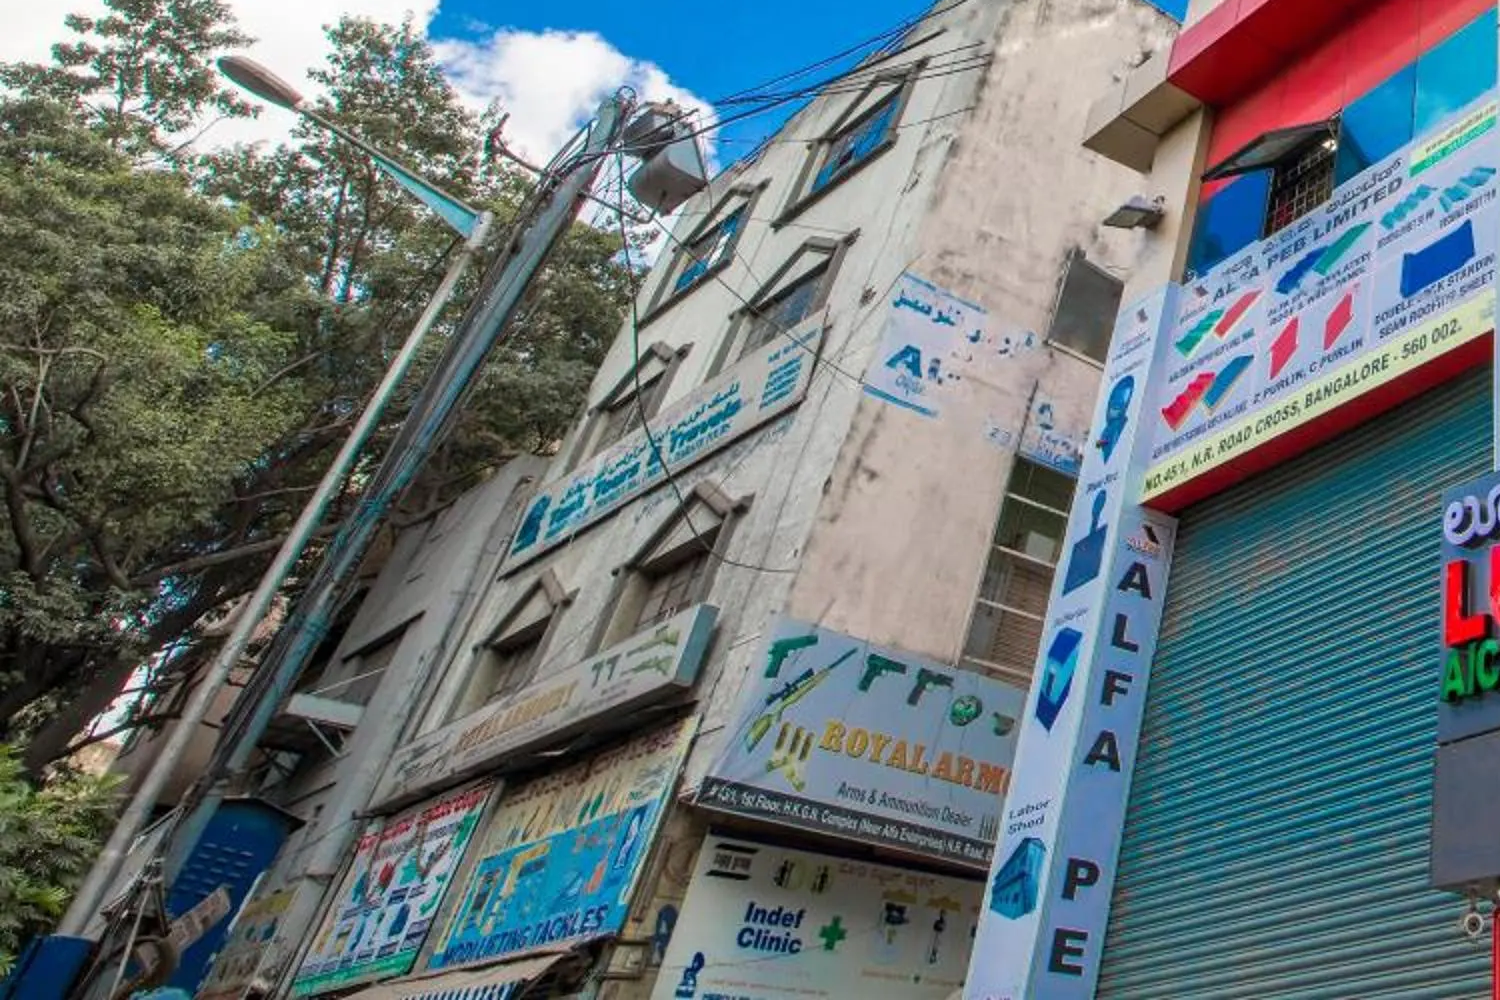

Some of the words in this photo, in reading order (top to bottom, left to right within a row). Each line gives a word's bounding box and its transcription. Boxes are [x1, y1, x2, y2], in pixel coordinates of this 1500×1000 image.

[1314, 176, 1405, 243] LIMITED
[1217, 430, 1253, 459] ROAD
[1255, 407, 1301, 440] CROSS,
[1304, 354, 1390, 416] BANGALORE
[1401, 336, 1428, 361] 560
[930, 754, 1013, 797] ARM
[744, 901, 806, 929] Indef
[736, 926, 804, 955] Clinic
